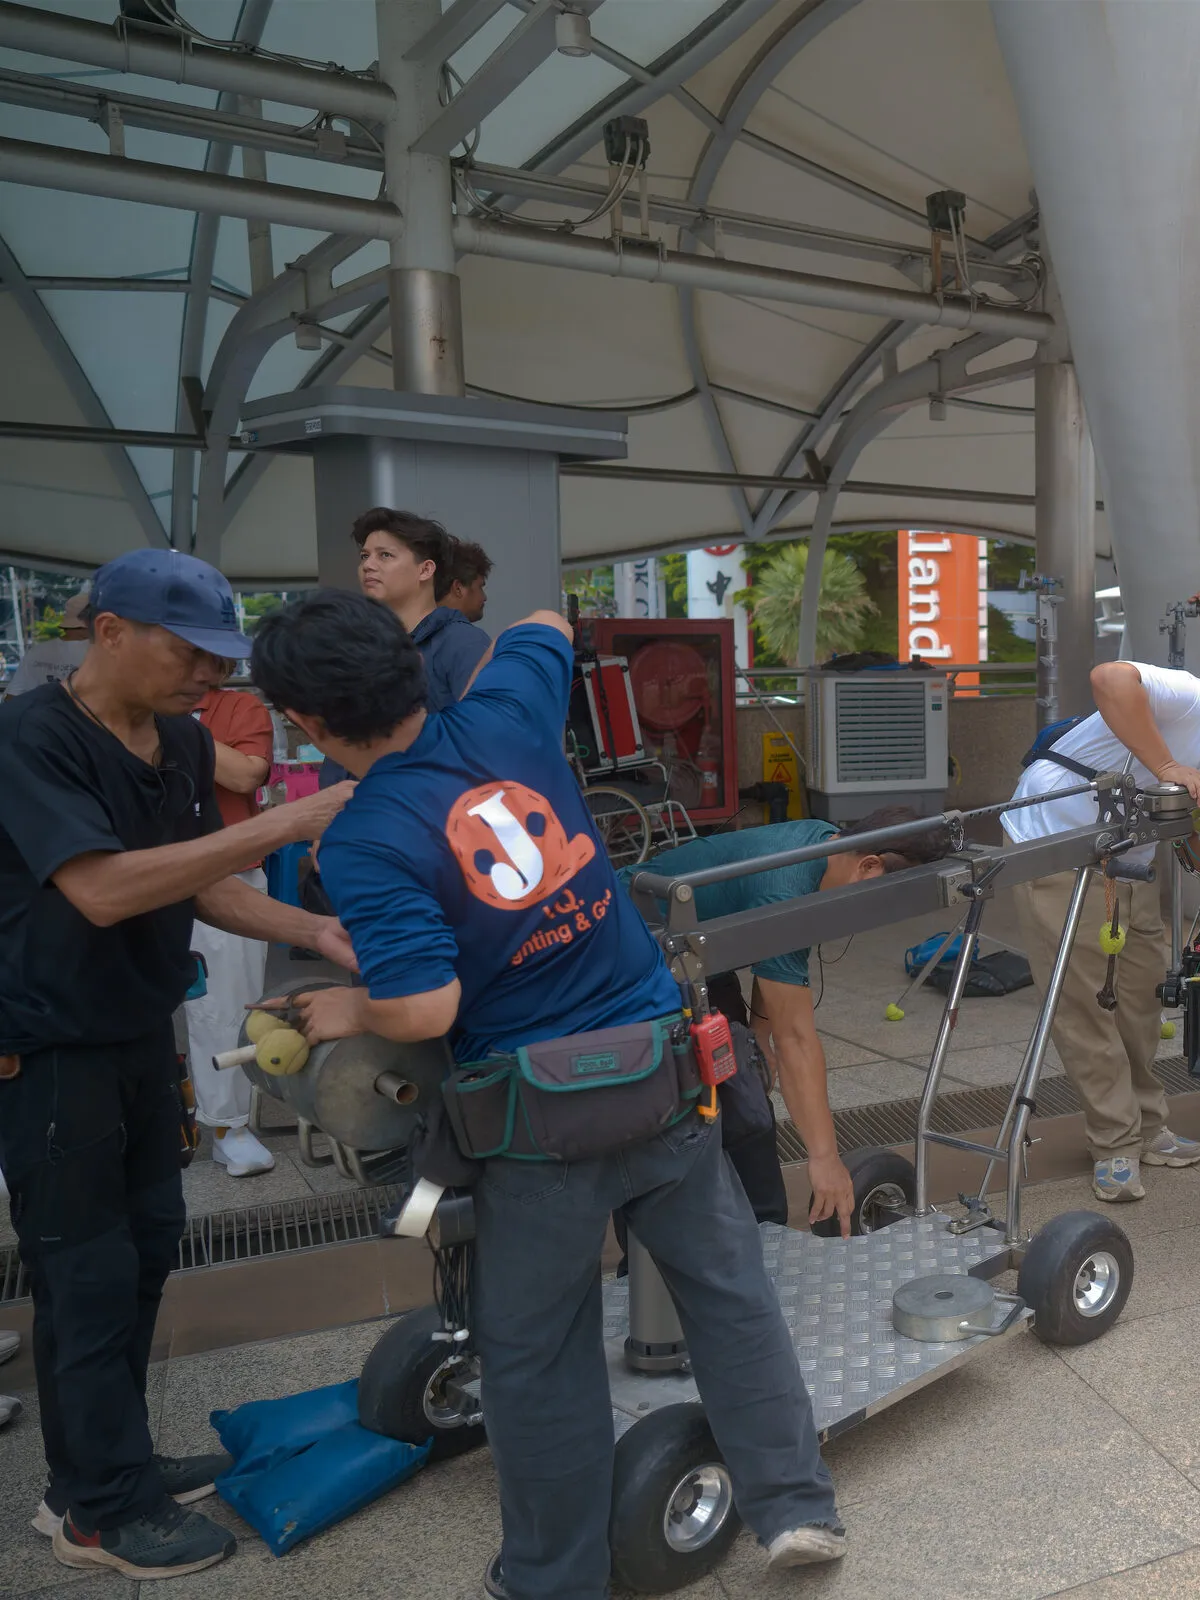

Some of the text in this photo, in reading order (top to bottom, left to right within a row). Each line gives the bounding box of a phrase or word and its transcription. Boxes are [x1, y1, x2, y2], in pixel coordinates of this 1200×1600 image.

[706, 570, 732, 606] 中
[908, 530, 952, 661] land
[575, 912, 592, 932] &
